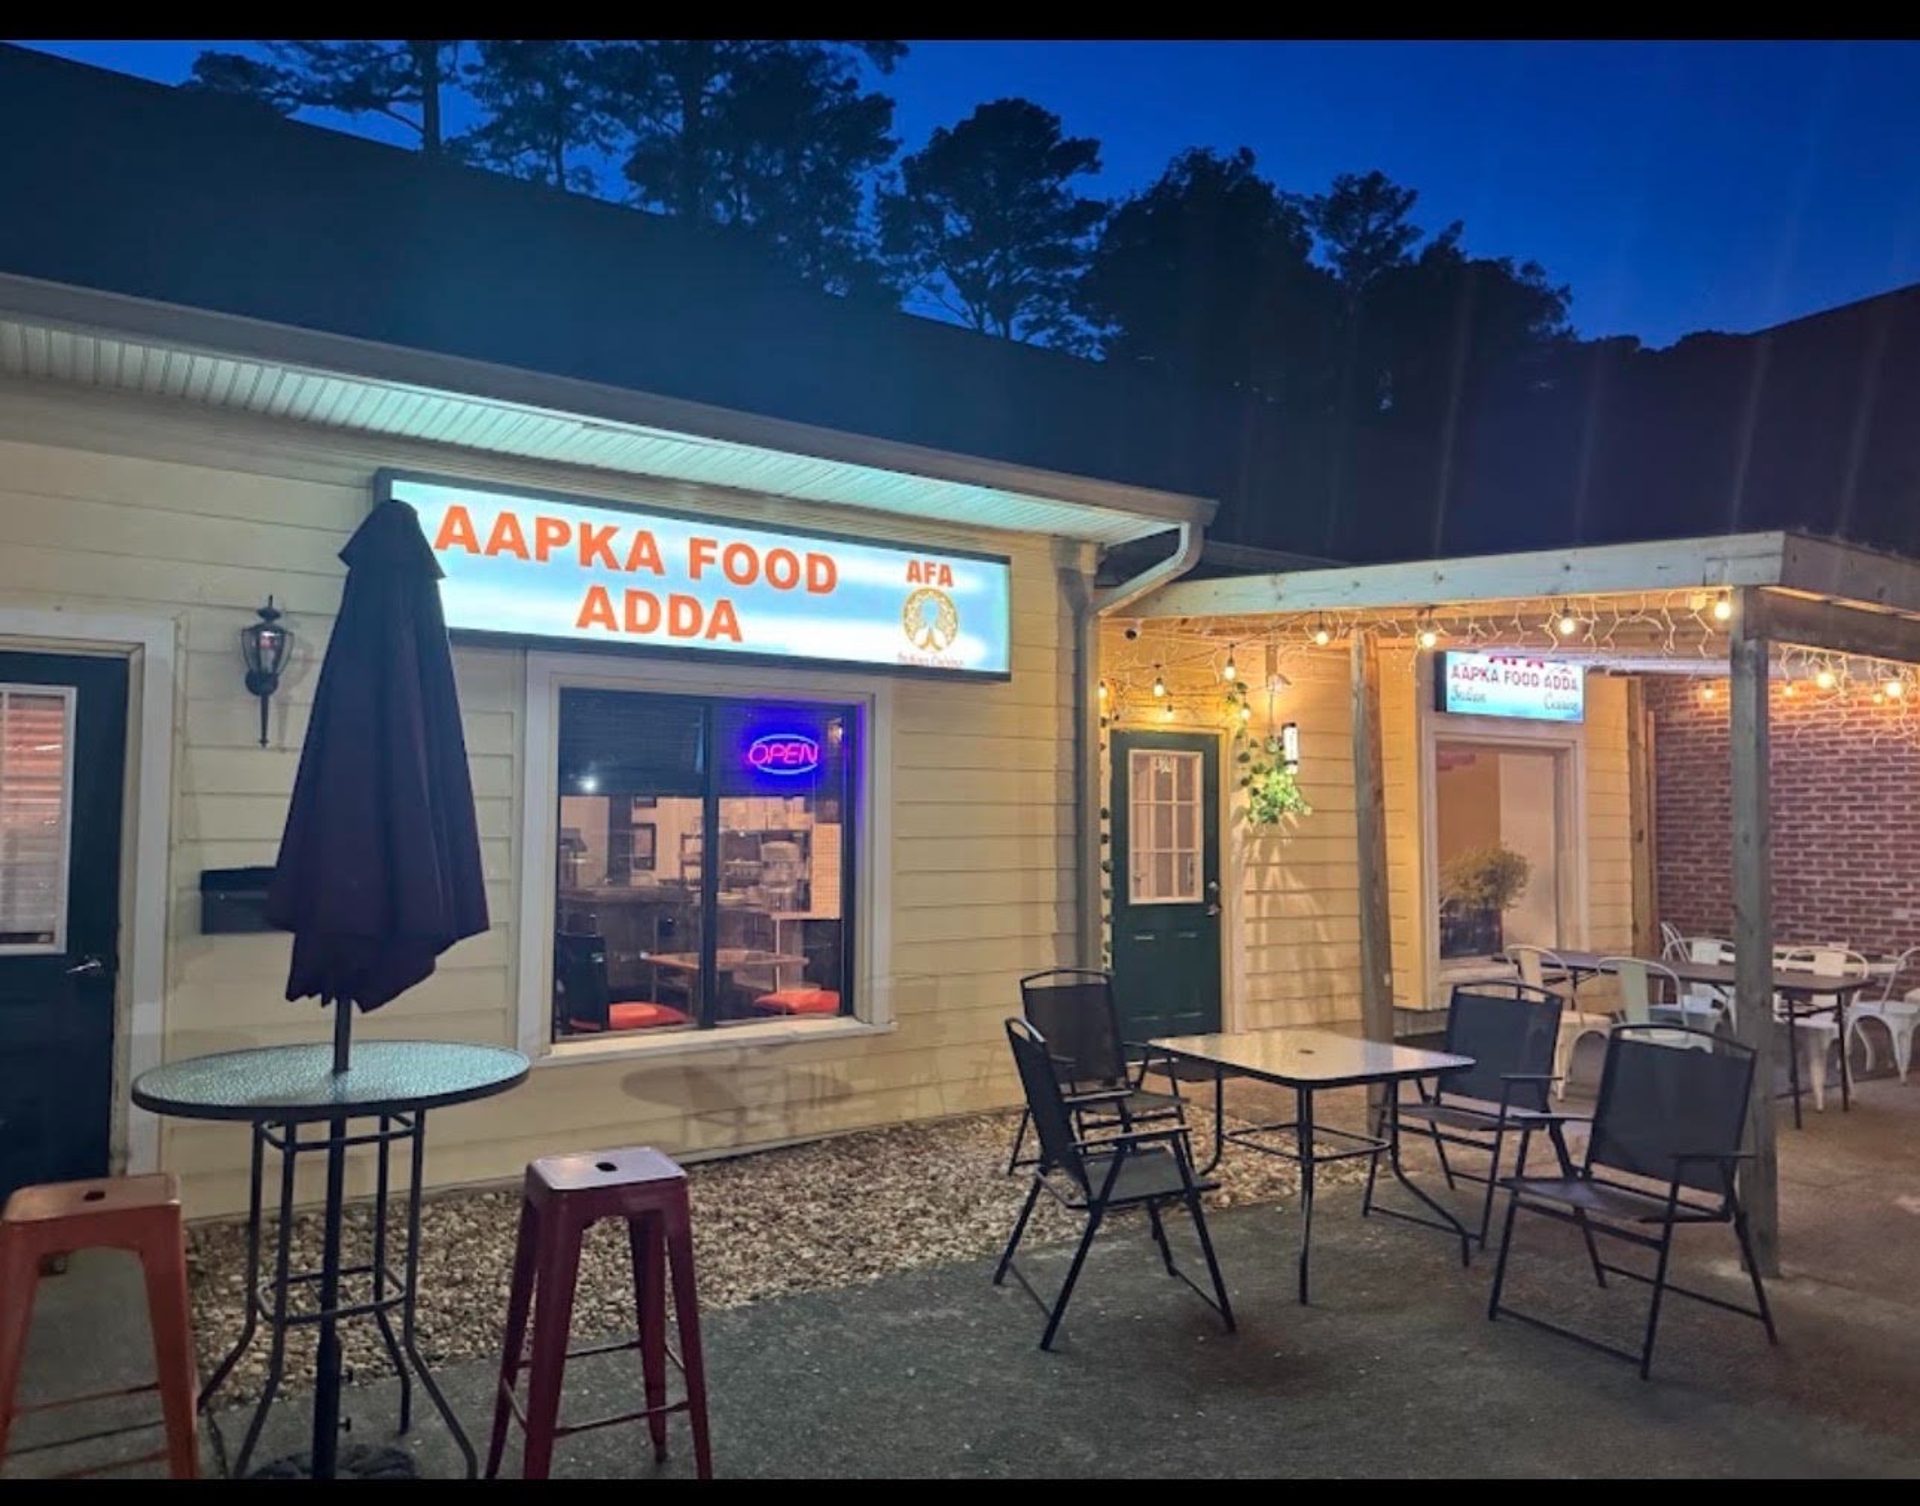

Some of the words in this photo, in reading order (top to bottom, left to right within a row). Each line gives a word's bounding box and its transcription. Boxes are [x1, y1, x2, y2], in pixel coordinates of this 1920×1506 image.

[435, 505, 665, 575] AAPKA
[688, 537, 839, 595] FOOD
[906, 560, 954, 588] AFA
[576, 585, 743, 642] ADDA
[1451, 664, 1499, 684] AAPKA
[1504, 670, 1540, 688] FOOD
[1543, 674, 1578, 692] ADDA
[749, 743, 819, 764] OPEN
